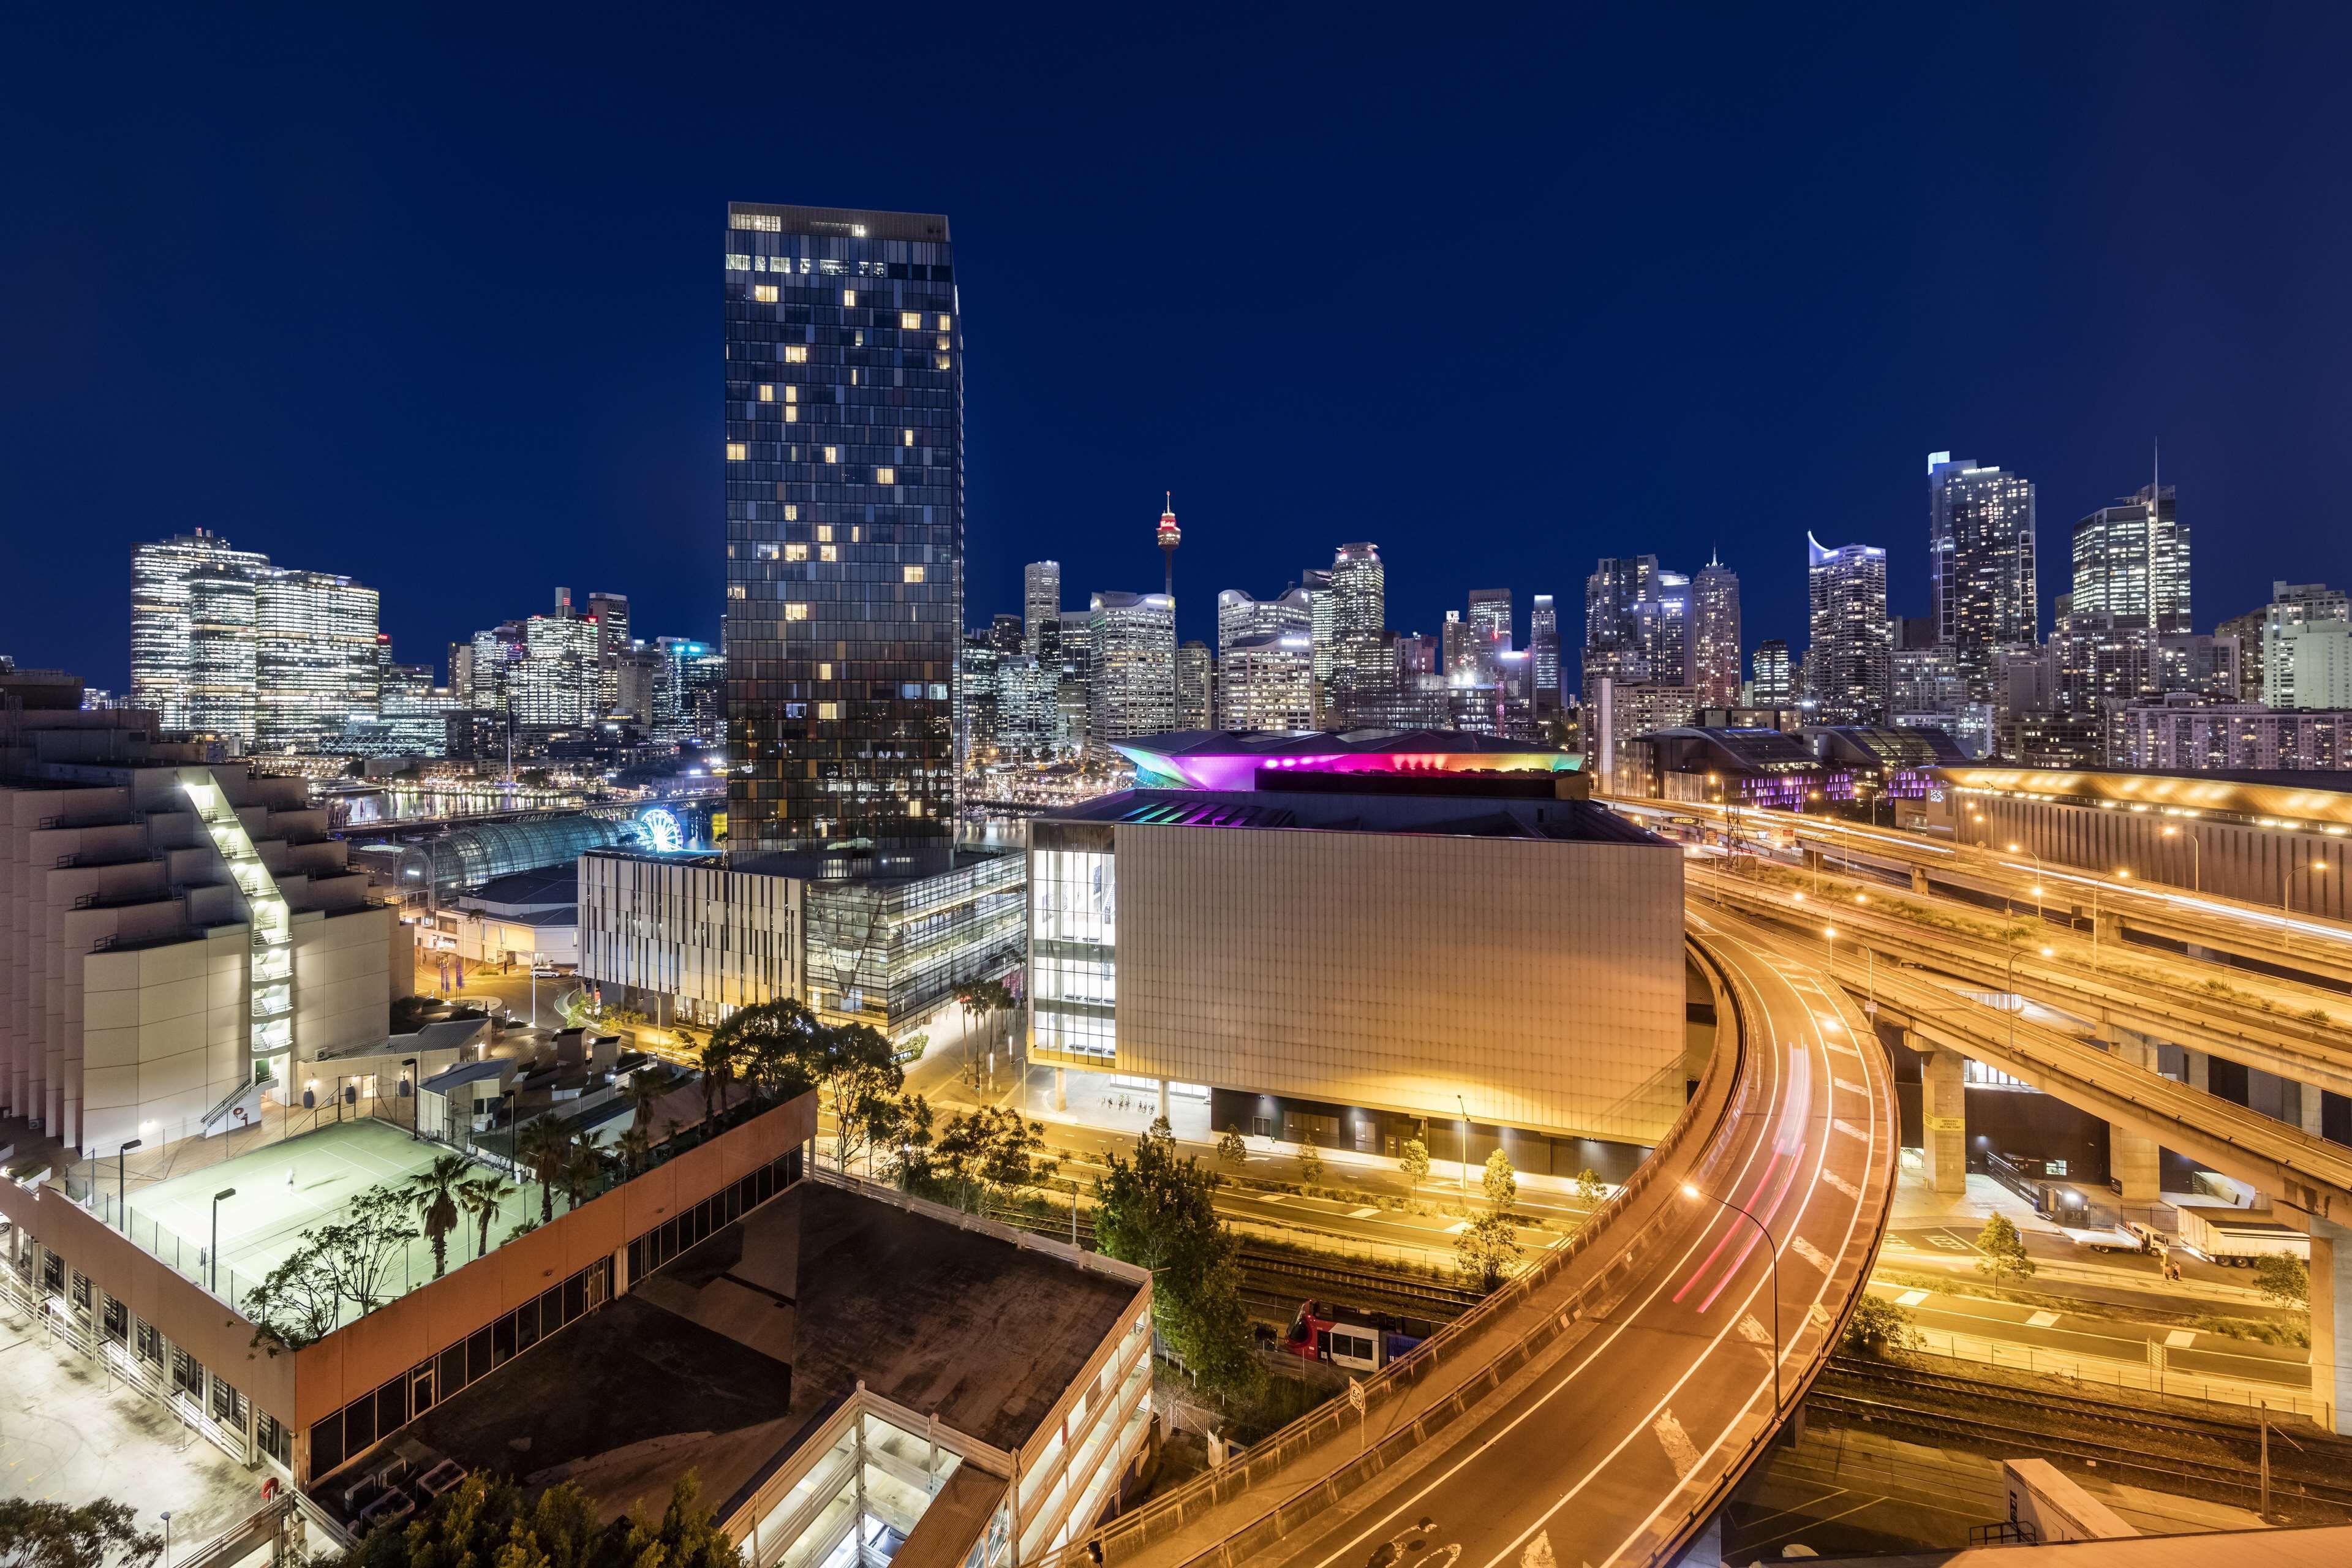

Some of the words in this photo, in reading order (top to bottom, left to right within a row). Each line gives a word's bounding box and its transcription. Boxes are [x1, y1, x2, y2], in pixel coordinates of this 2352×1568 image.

[2071, 1211, 2081, 1220] 14
[1921, 1235, 1969, 1250] KEEP
[1352, 1389, 1362, 1403] 60
